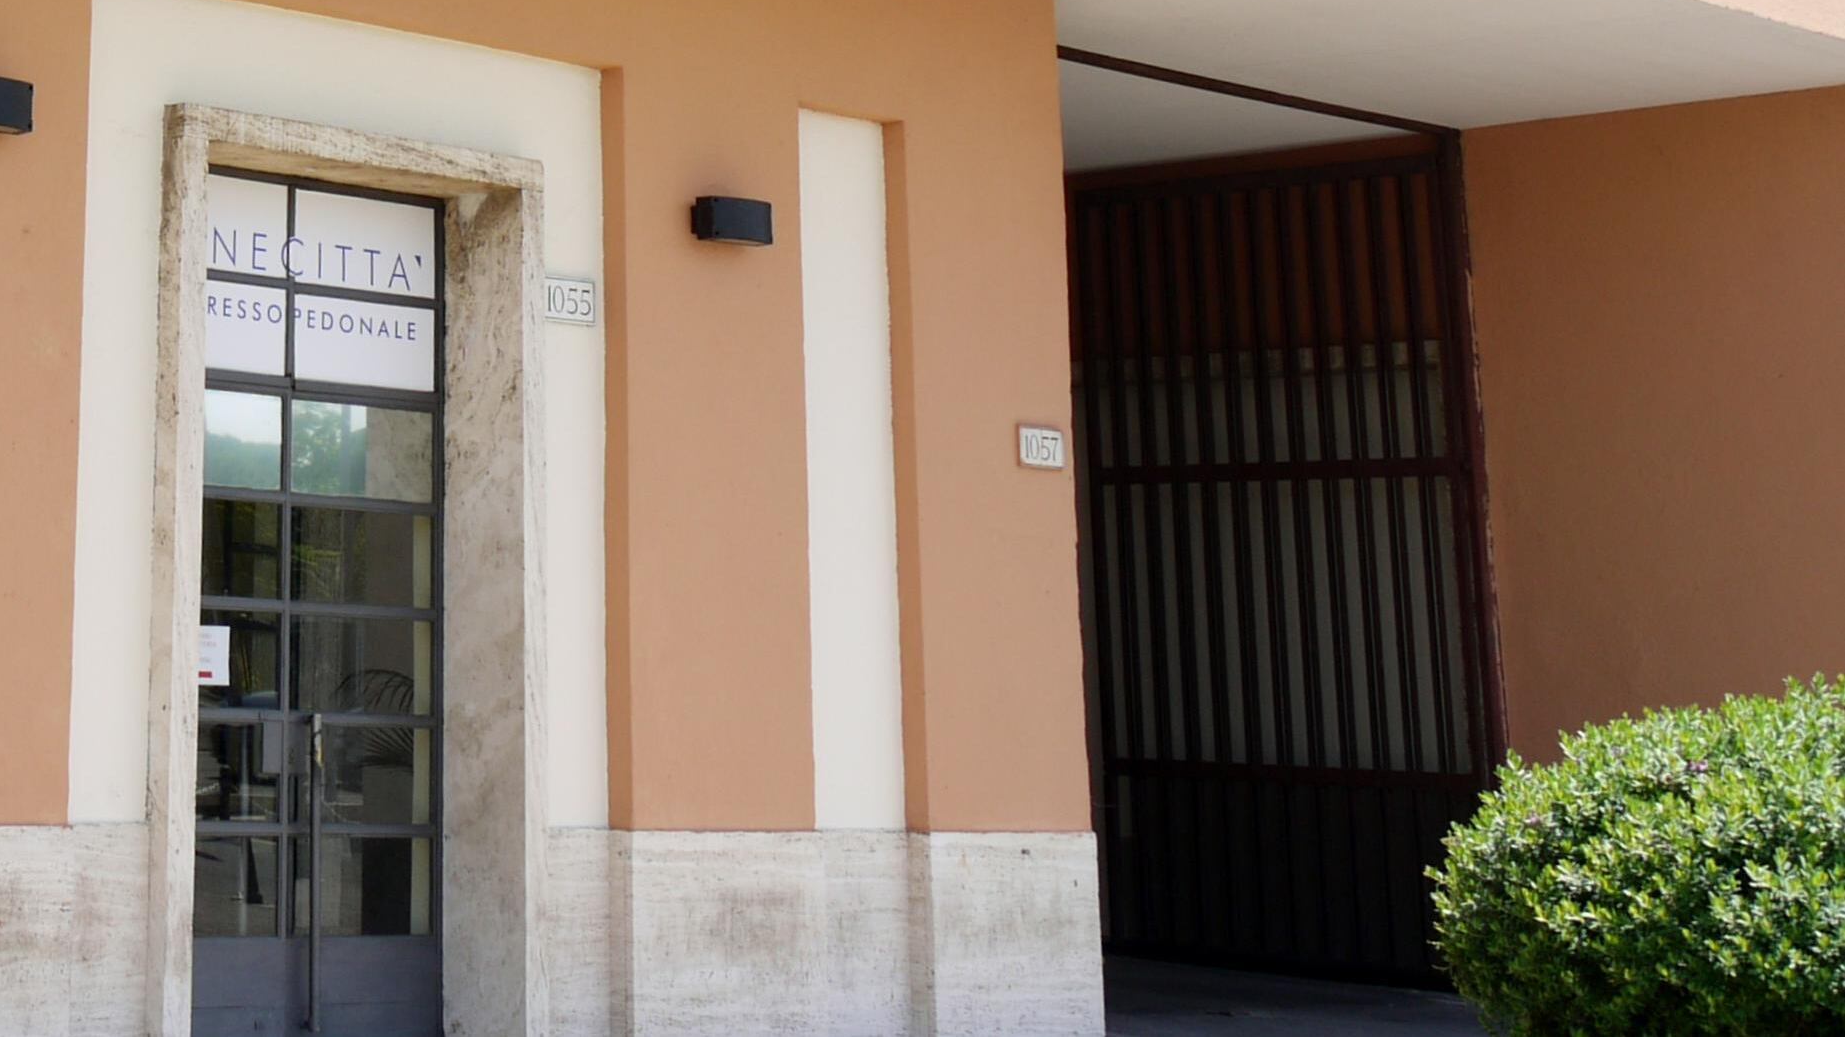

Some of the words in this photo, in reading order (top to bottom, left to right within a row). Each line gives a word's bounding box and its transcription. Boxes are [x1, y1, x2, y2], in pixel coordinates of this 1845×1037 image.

[547, 284, 592, 316] 1055
[292, 307, 417, 341] PEDONALE
[1024, 434, 1059, 461] 1057
